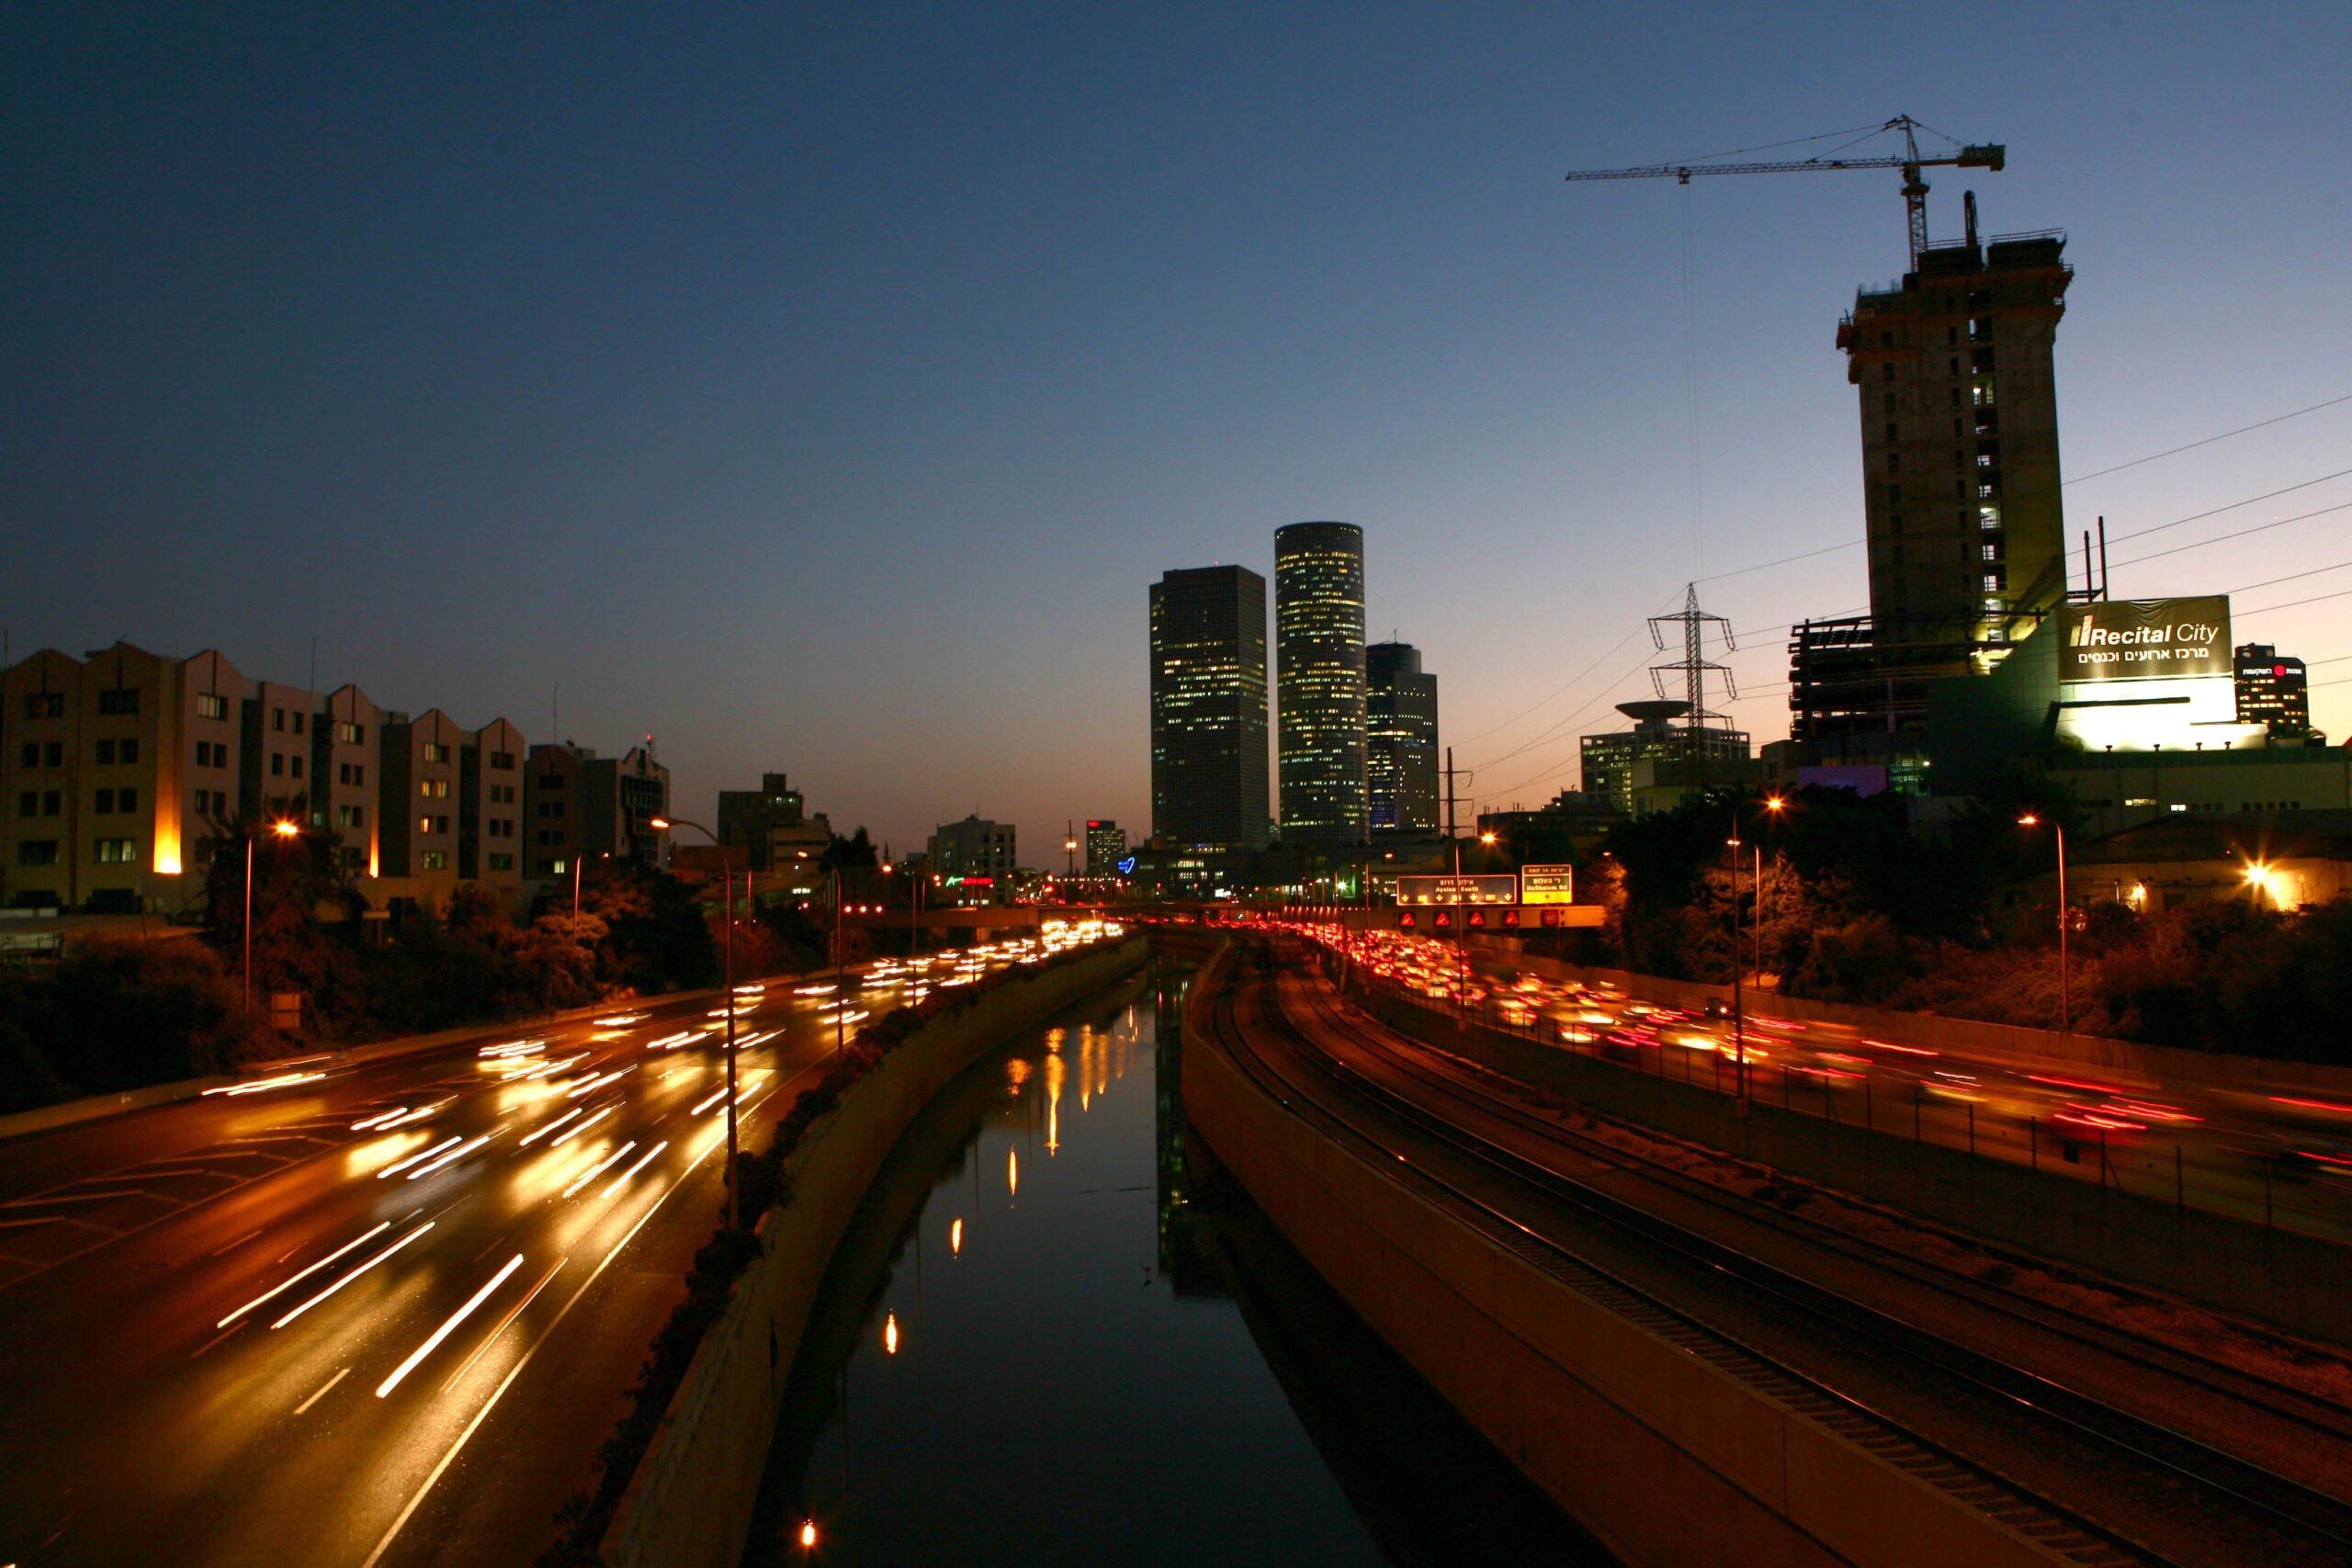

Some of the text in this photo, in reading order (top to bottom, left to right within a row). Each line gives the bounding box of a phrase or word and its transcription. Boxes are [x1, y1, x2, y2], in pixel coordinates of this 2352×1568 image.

[2090, 623, 2219, 646] Recital City
[2078, 647, 2210, 664] מרכז ארועים וכנסים
